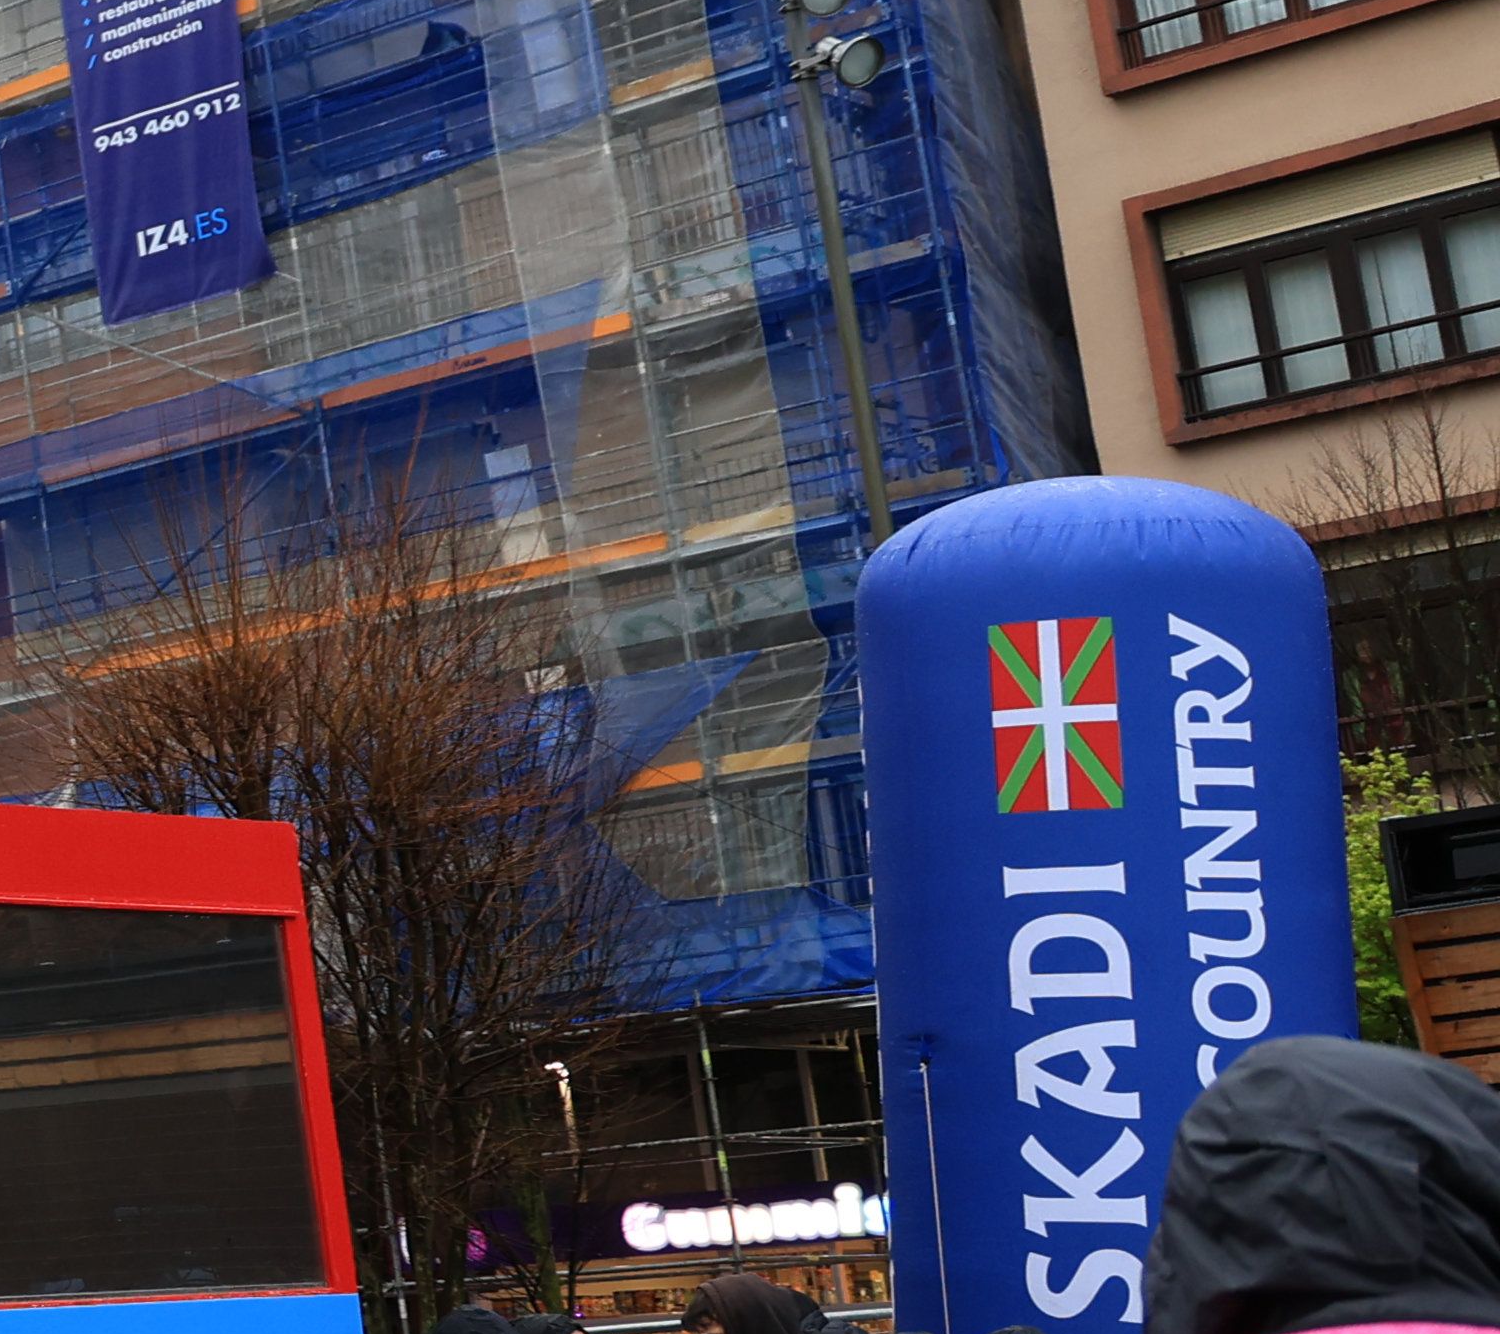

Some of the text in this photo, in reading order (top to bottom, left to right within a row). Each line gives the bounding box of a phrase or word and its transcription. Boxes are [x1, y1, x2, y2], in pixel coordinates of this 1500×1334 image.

[103, 19, 203, 63] construcción
[94, 93, 242, 154] 943 460 912
[136, 207, 229, 258] IZ4.ES
